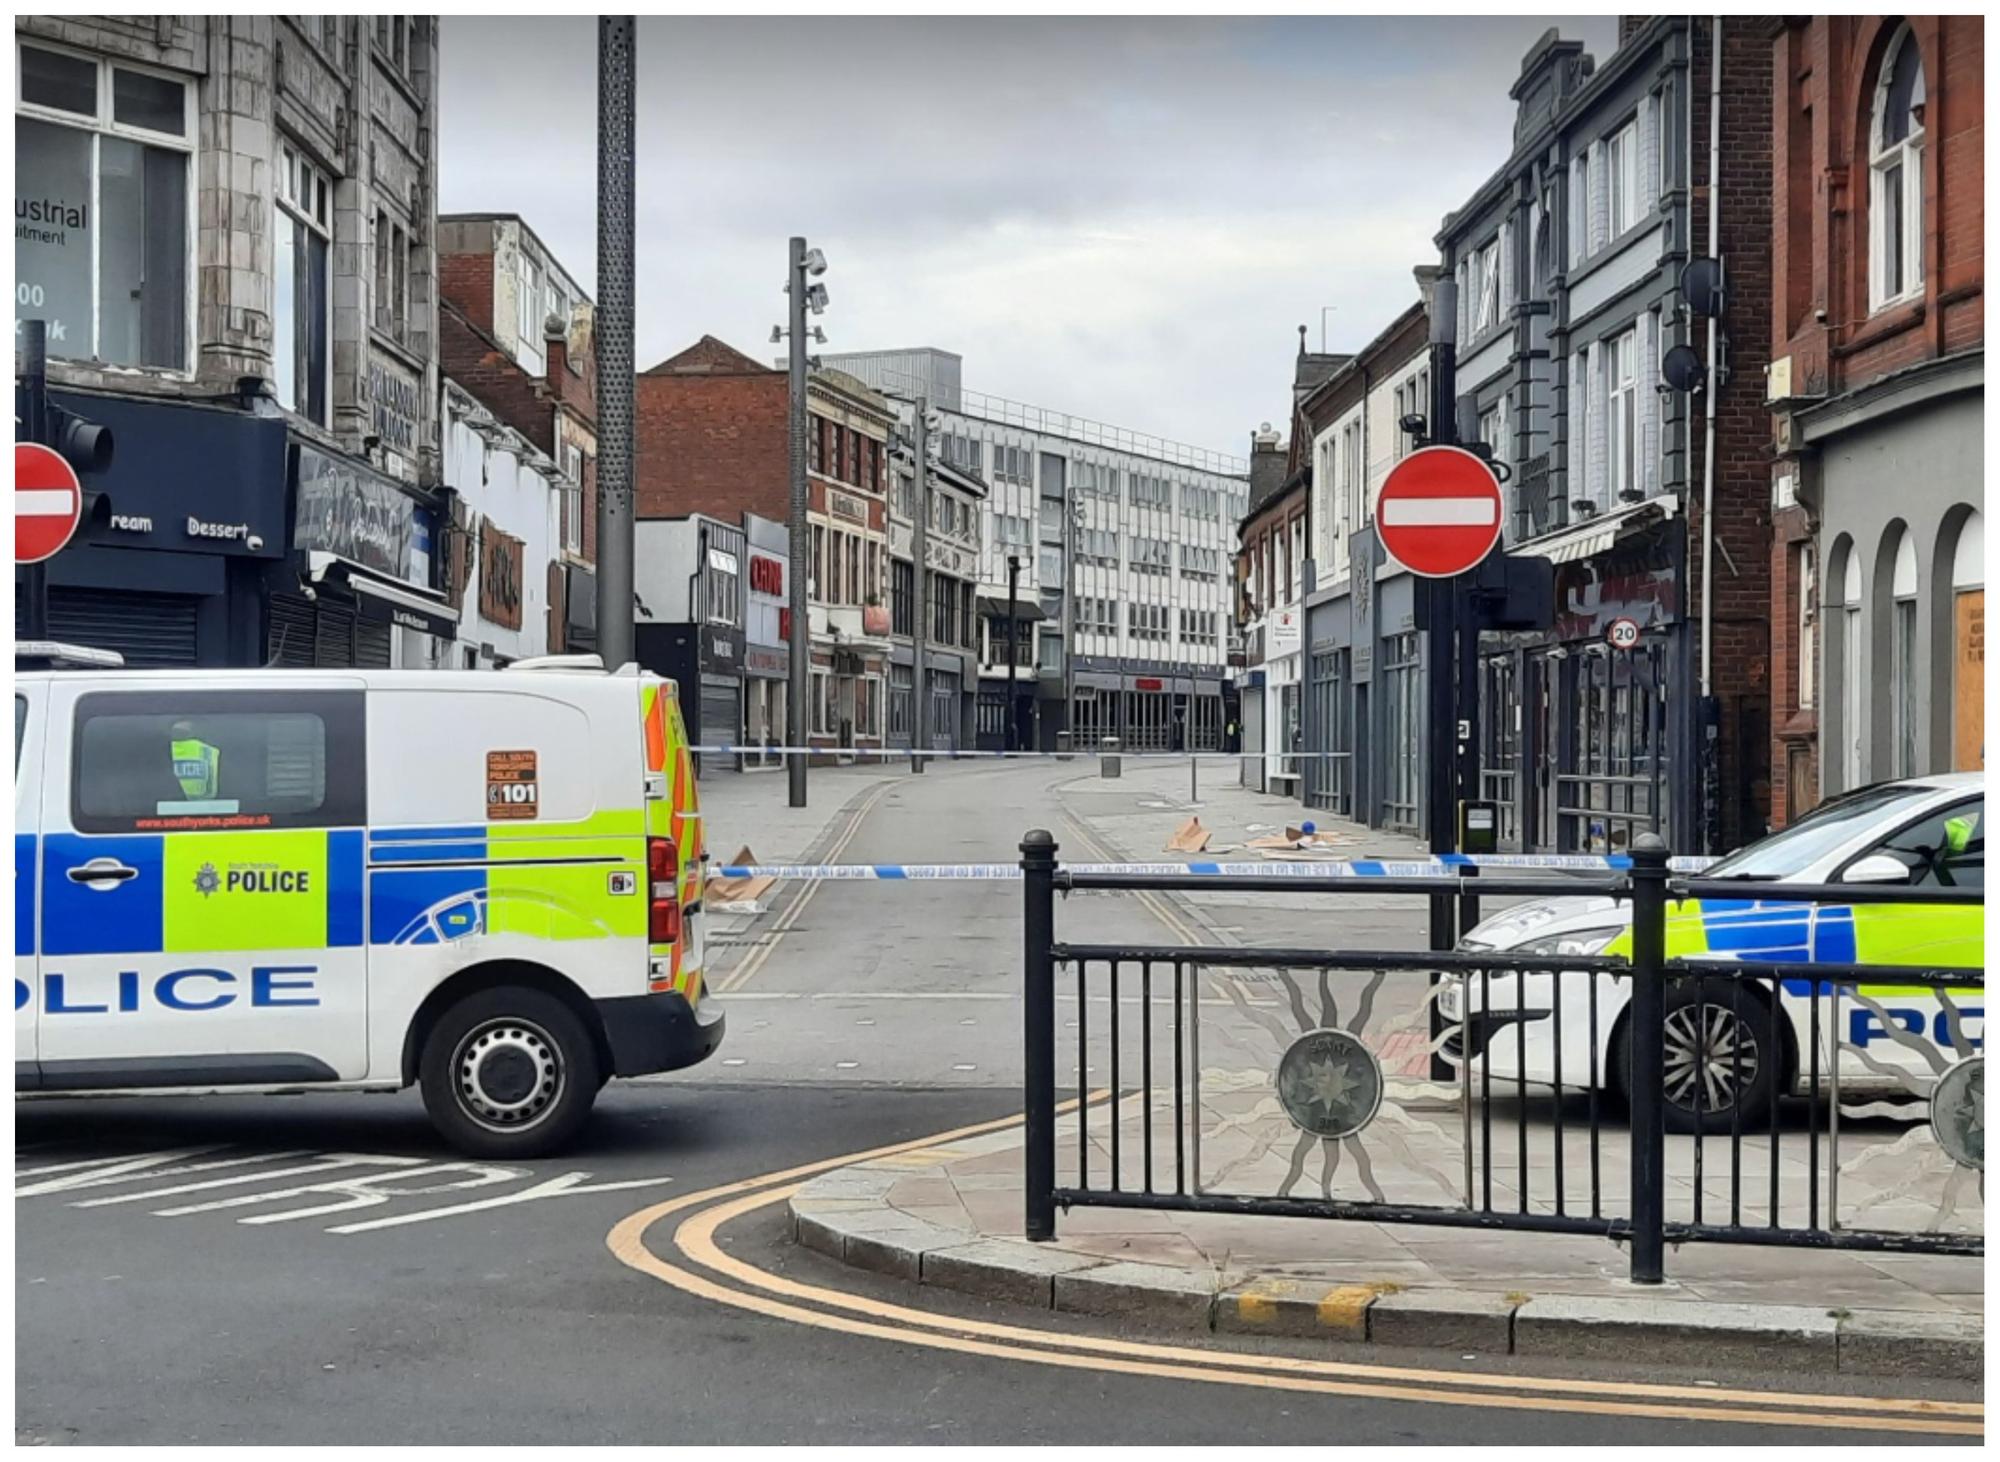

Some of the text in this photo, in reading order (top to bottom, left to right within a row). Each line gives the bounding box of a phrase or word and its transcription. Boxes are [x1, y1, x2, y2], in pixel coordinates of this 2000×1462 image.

[15, 283, 44, 307] 00
[111, 514, 249, 540] ream Dessert
[1614, 627, 1635, 641] 20
[503, 783, 536, 803] 101
[227, 871, 309, 892] POLICE
[15, 966, 320, 1013] LICE
